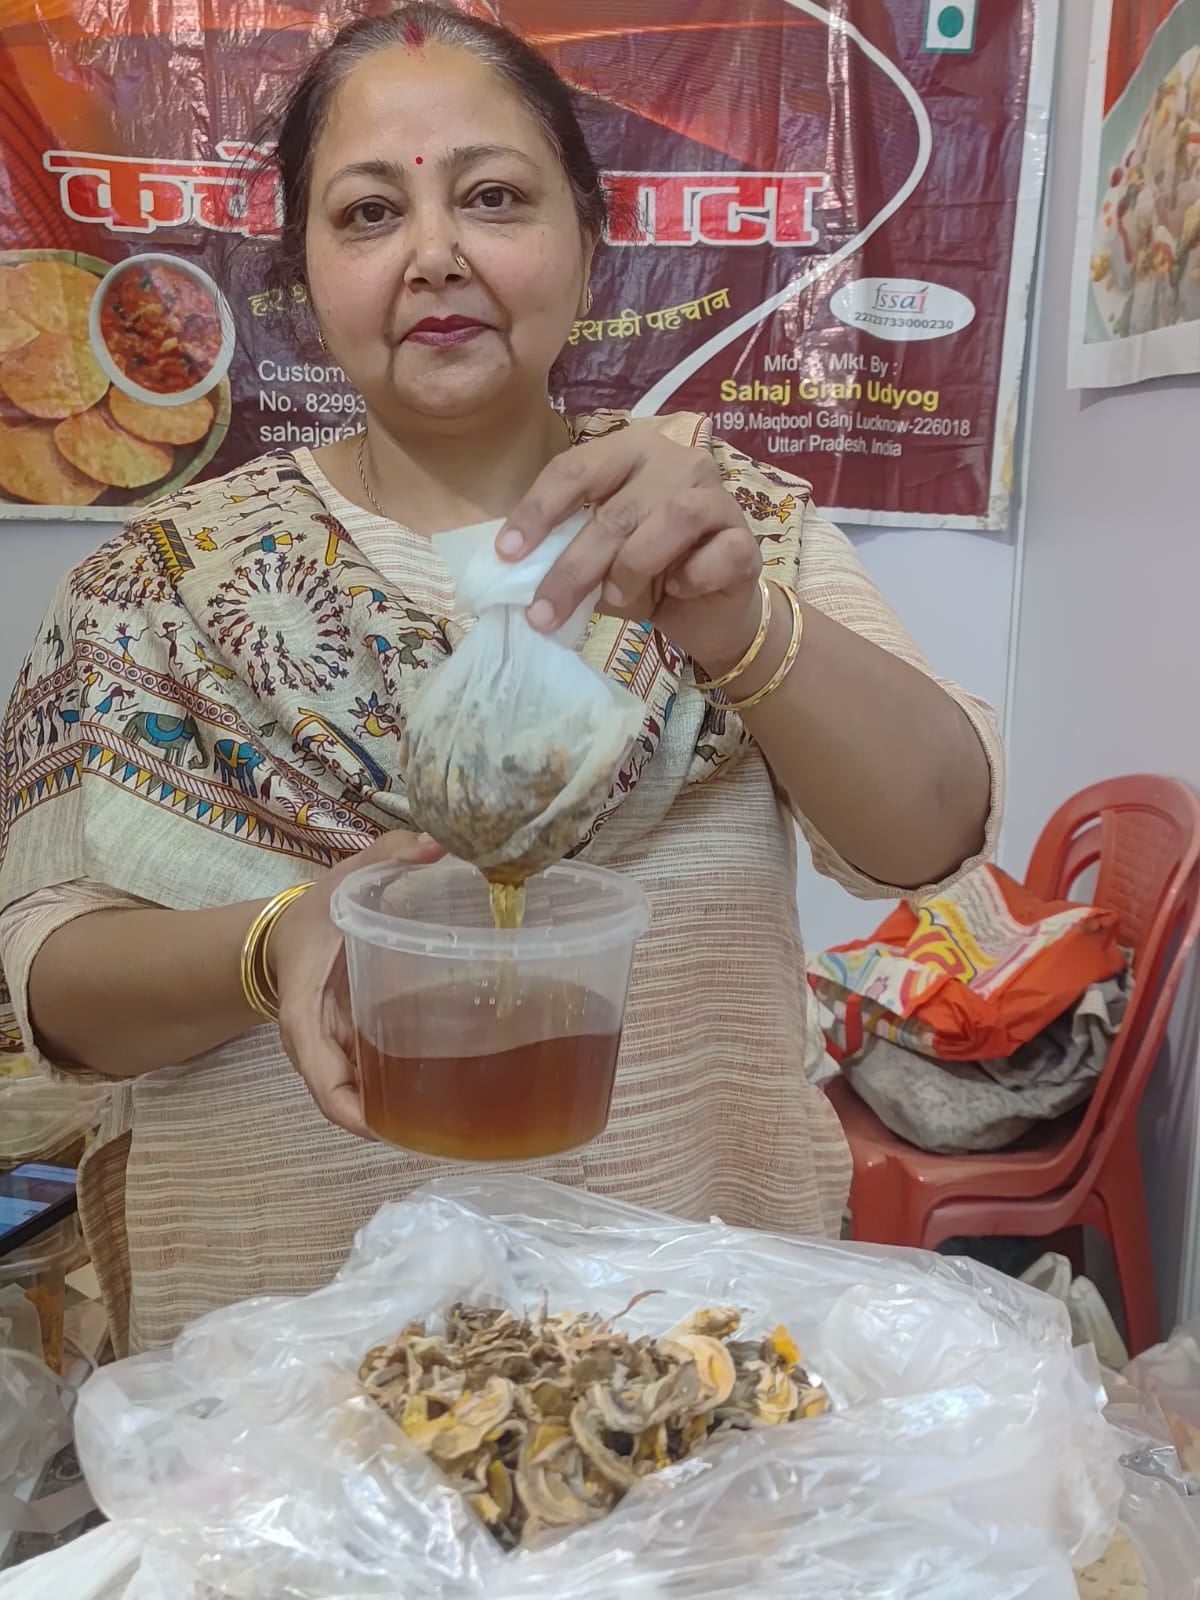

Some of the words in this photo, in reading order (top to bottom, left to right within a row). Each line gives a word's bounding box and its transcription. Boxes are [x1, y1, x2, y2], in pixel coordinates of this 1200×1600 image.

[645, 288, 731, 331] पहचान
[872, 283, 929, 314] fssai
[258, 359, 352, 383] Custom
[870, 355, 889, 378] By
[260, 390, 298, 412] No.
[720, 380, 791, 406] Sahaj
[867, 380, 939, 412] Udyog
[816, 410, 853, 432] Ganj
[767, 435, 806, 453] Uttar
[871, 438, 903, 456] India
